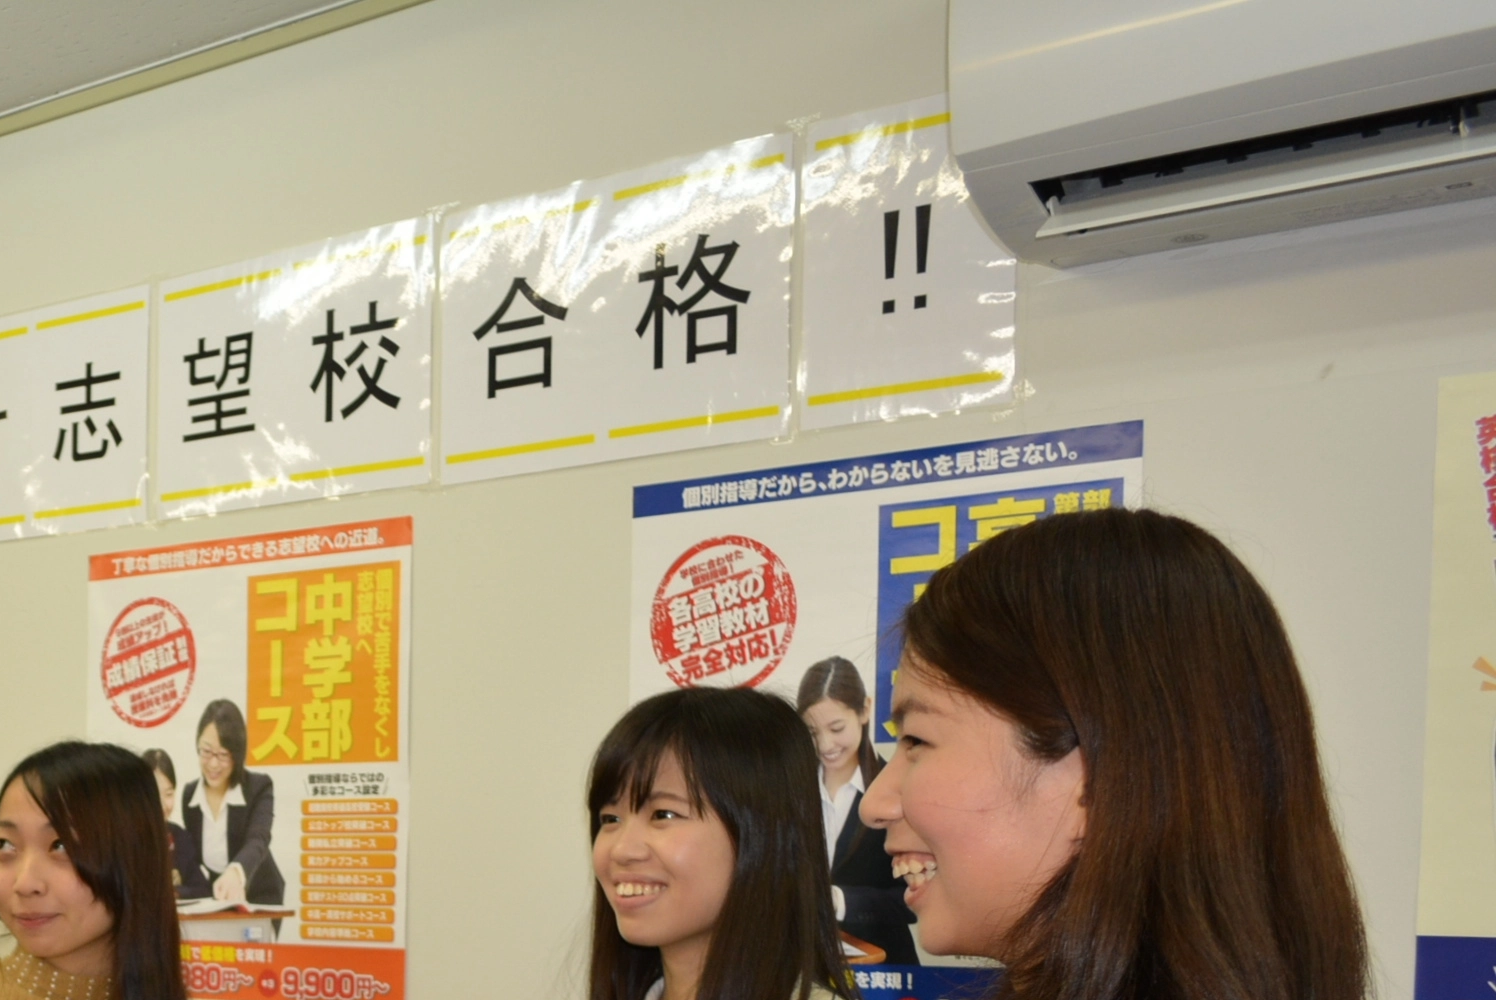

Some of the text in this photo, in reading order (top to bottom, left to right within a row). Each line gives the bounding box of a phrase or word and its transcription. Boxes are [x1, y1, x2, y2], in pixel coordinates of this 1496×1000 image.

[681, 441, 1078, 508] 個別指導だから、わからないを見逃さない。
[356, 570, 376, 654] 志望校へ
[668, 571, 766, 623] 各高校の
[672, 597, 770, 652] 学習教材
[251, 577, 299, 762] コース
[301, 572, 353, 761] 中学部
[680, 628, 779, 681] 完全対応!
